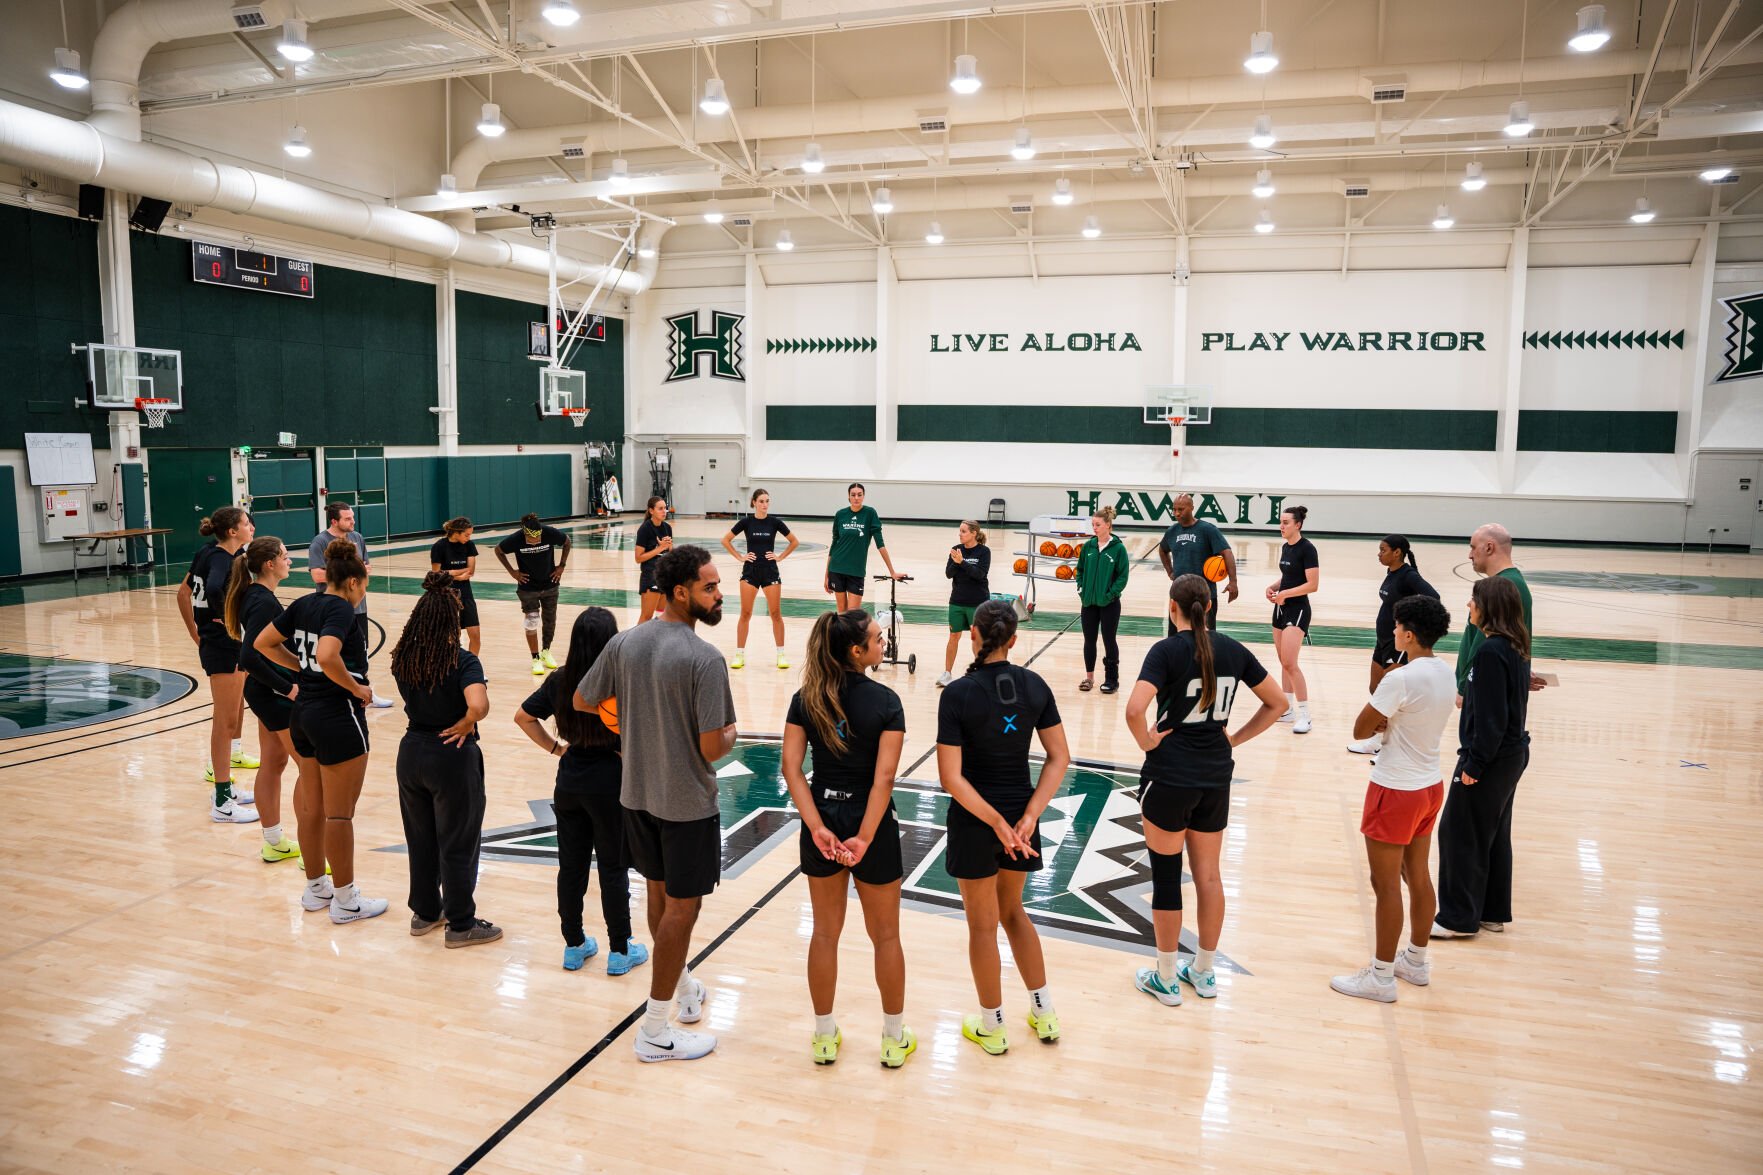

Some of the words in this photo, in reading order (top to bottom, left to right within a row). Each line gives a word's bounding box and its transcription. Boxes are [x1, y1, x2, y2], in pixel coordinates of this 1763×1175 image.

[199, 244, 221, 256] HOME
[212, 262, 220, 278] 0
[288, 260, 309, 272] GUEST
[242, 274, 258, 283] PERIOD
[300, 277, 309, 291] 0
[930, 334, 1008, 352] LIVE
[1020, 332, 1143, 352] ALOHA
[1201, 332, 1291, 351] PLAY
[1299, 332, 1486, 351] WARRIOR
[1182, 676, 1236, 723] 20
